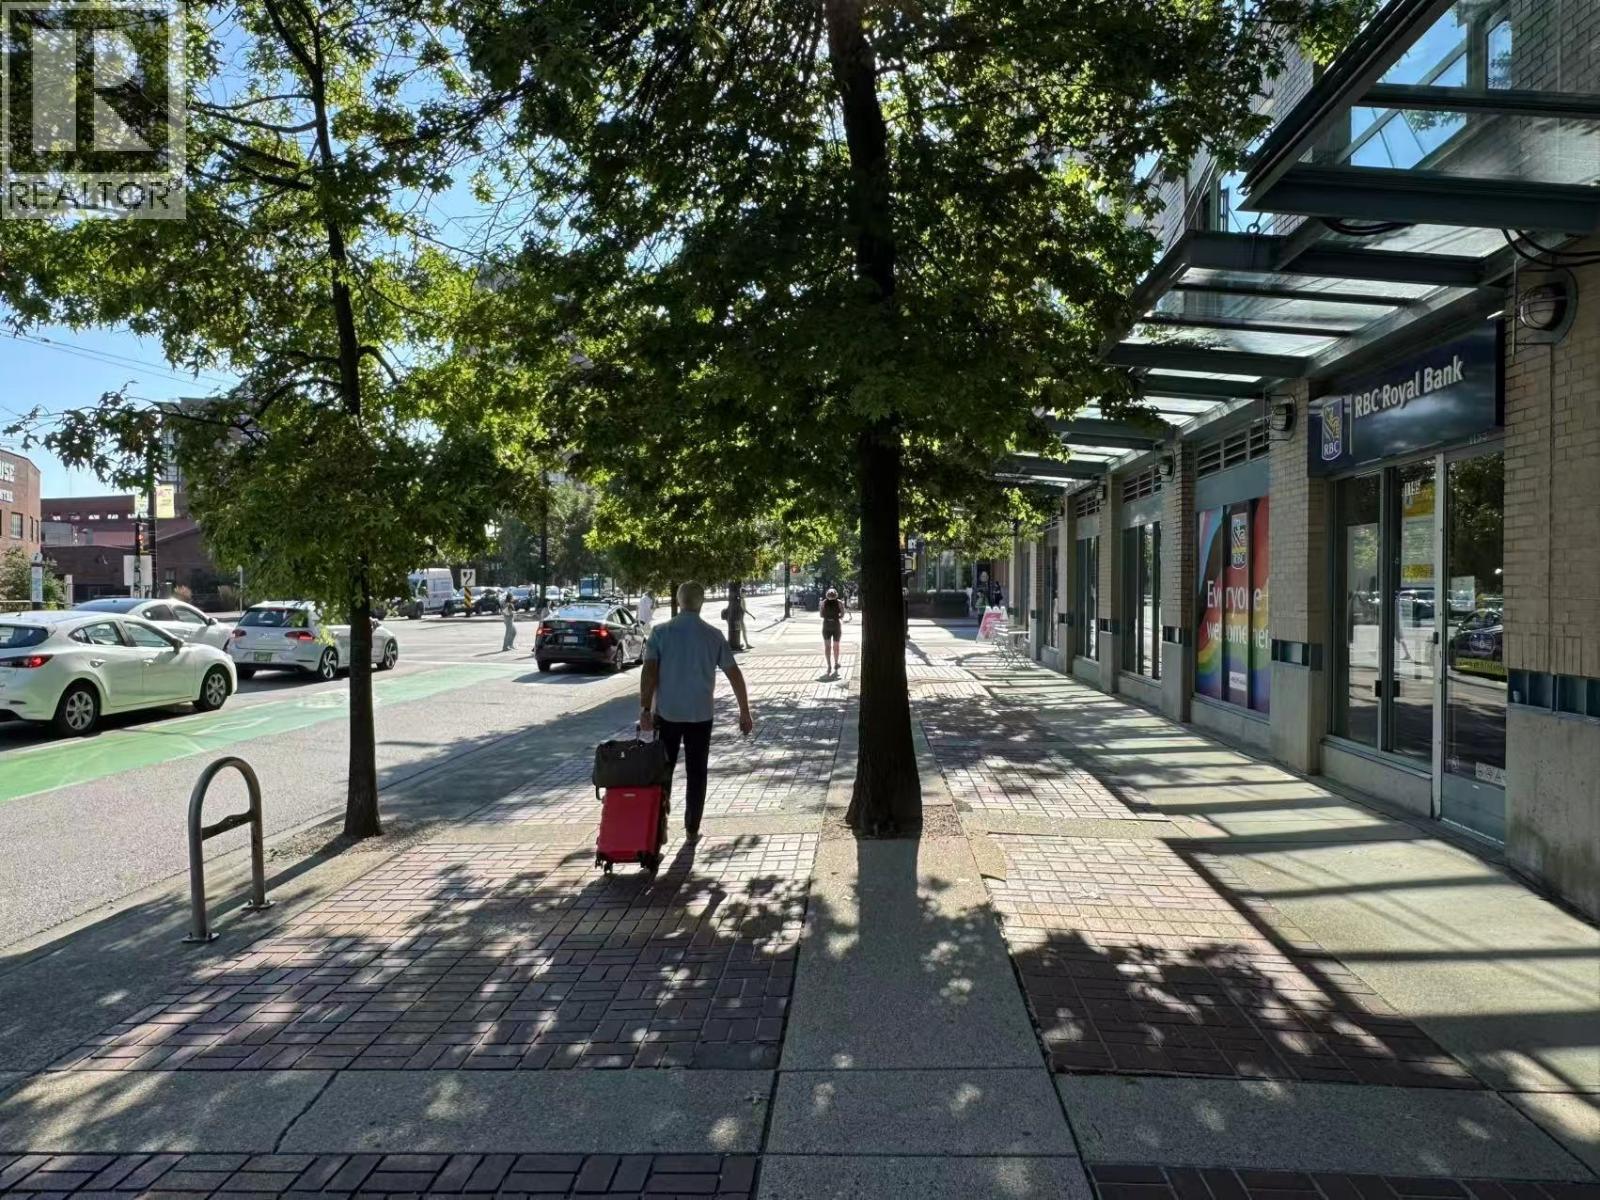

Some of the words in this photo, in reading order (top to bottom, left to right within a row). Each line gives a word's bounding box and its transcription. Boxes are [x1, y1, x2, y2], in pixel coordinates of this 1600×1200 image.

[1354, 388, 1379, 418] RBC
[1382, 371, 1420, 409] Royal
[1423, 355, 1464, 392] Bank
[1323, 441, 1340, 455] RBC
[1207, 617, 1248, 644] welome
